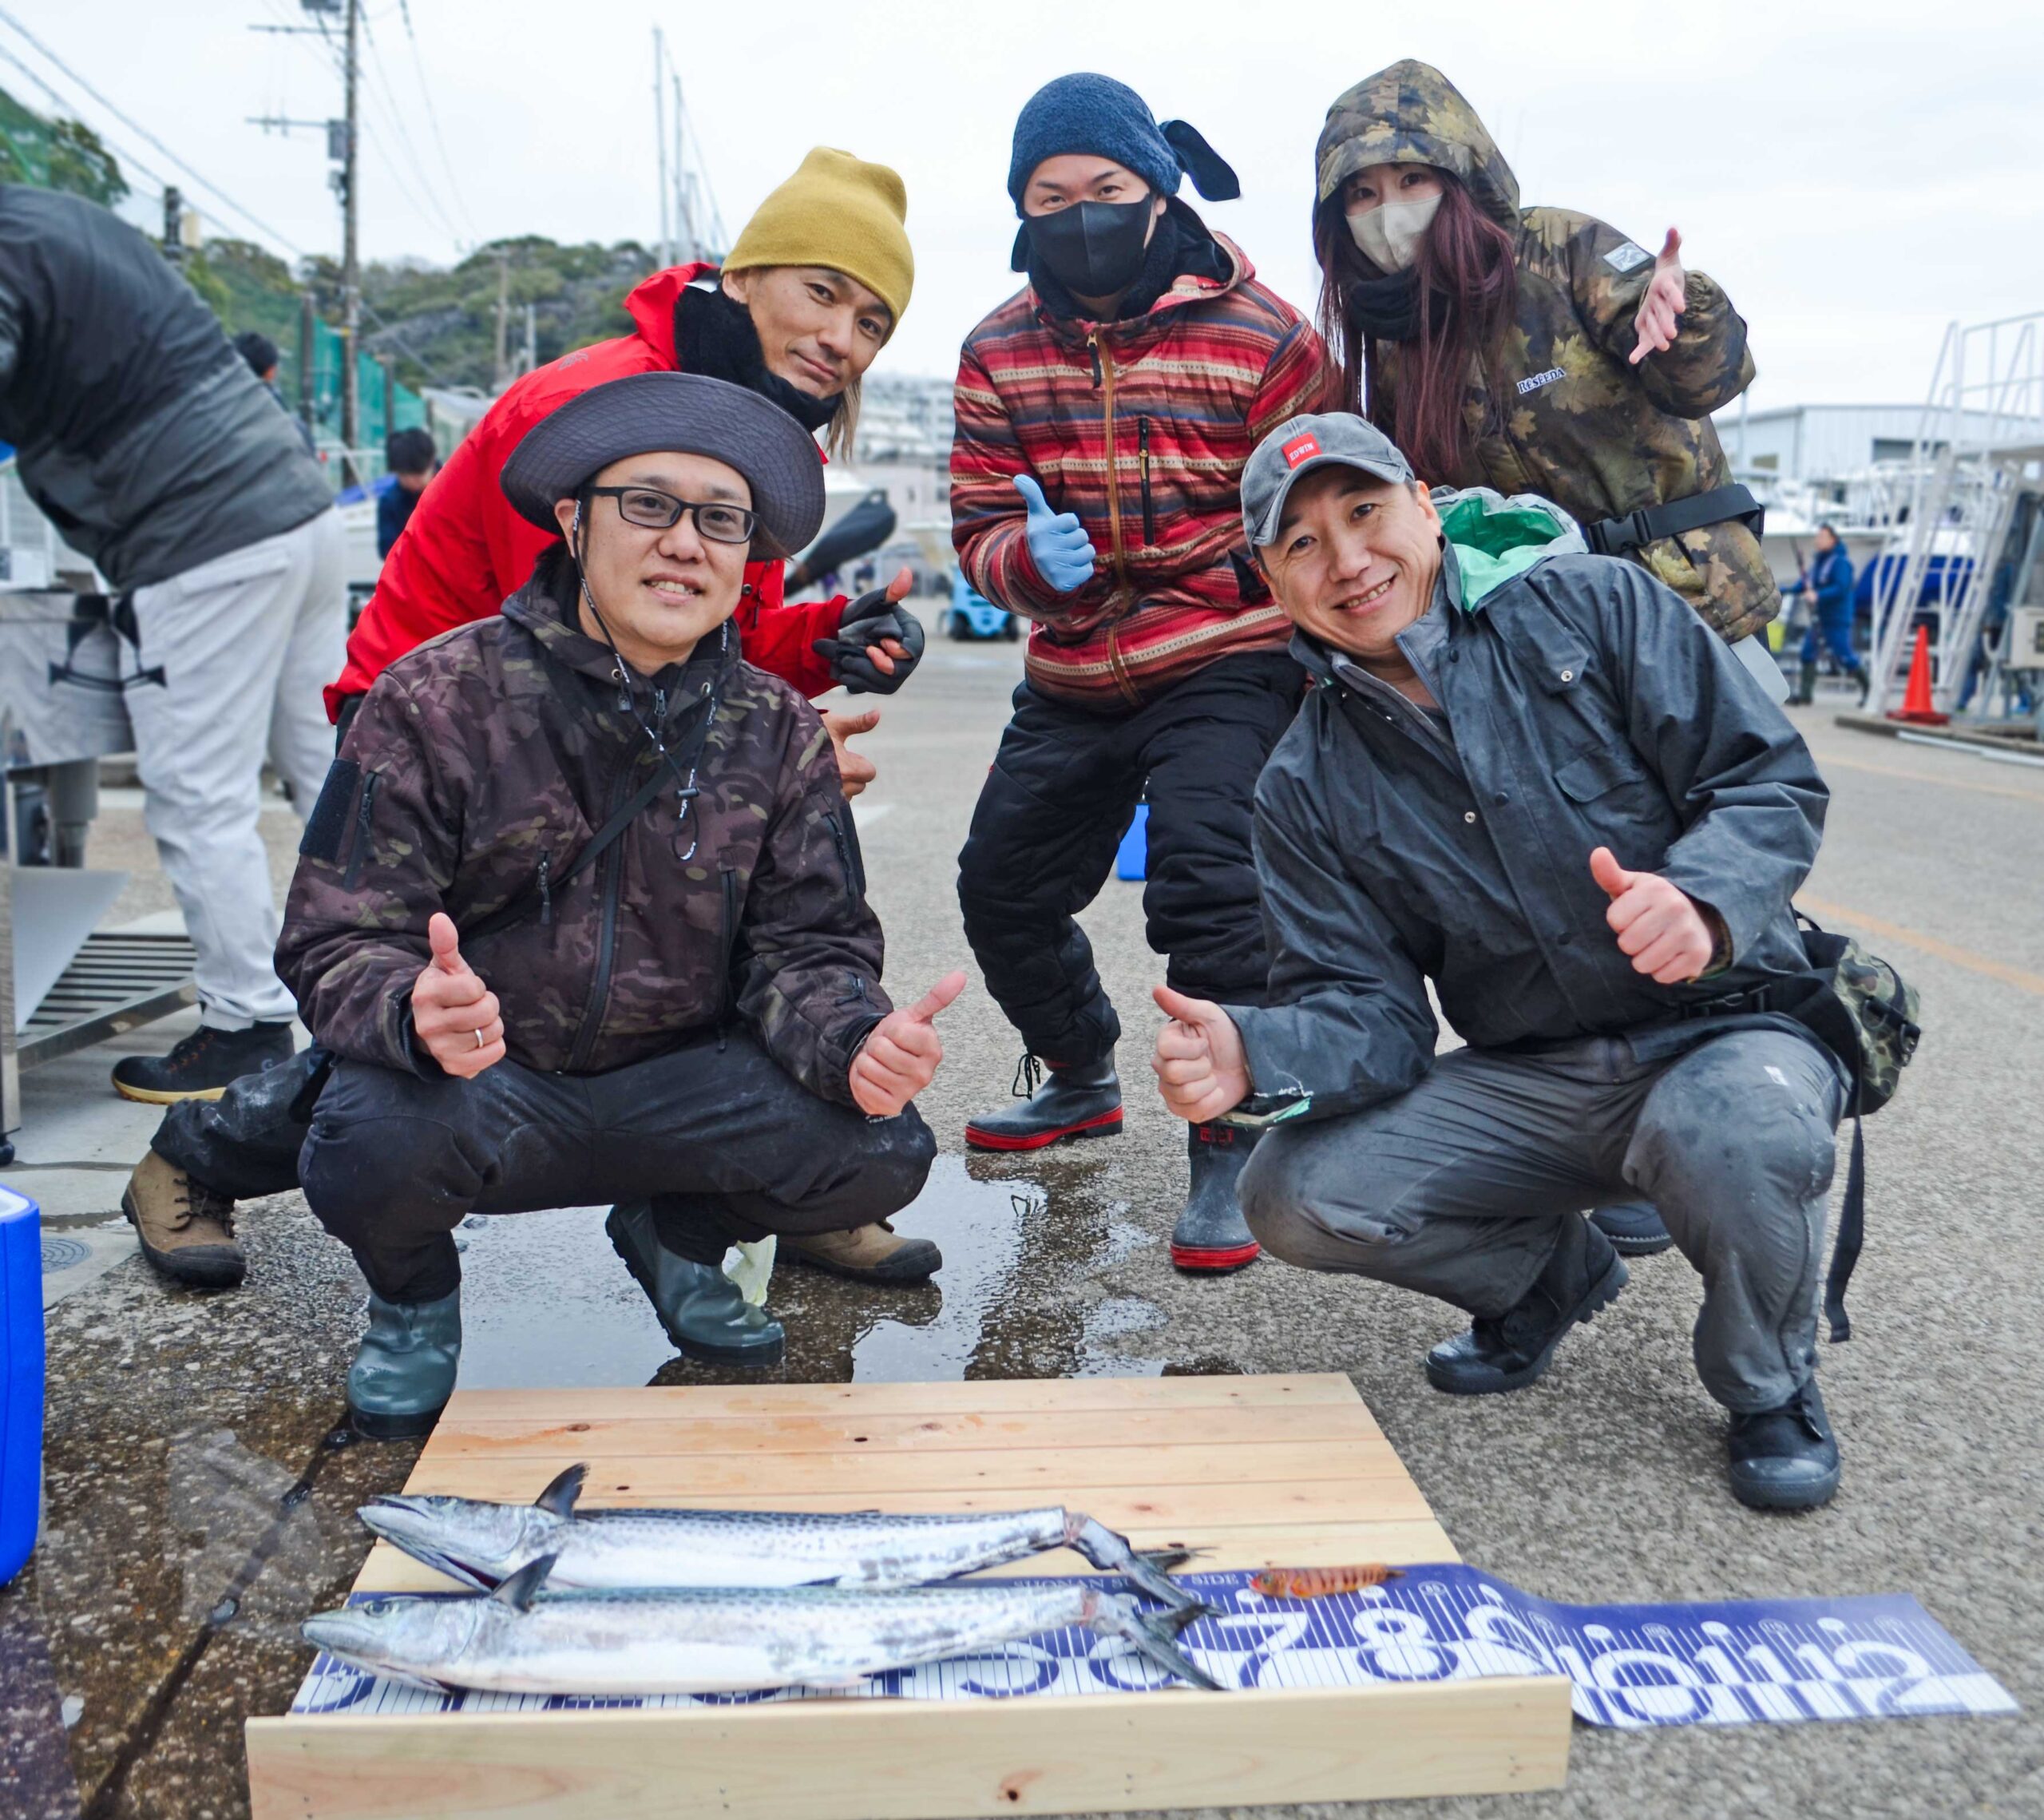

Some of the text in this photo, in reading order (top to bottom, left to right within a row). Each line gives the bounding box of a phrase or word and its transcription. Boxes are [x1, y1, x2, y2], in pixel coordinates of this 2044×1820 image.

[1289, 442, 1314, 461] EDWIN
[1191, 1573, 1238, 1585] SIDE
[1216, 1612, 1308, 1688] 7
[1353, 1608, 1460, 1680] 8
